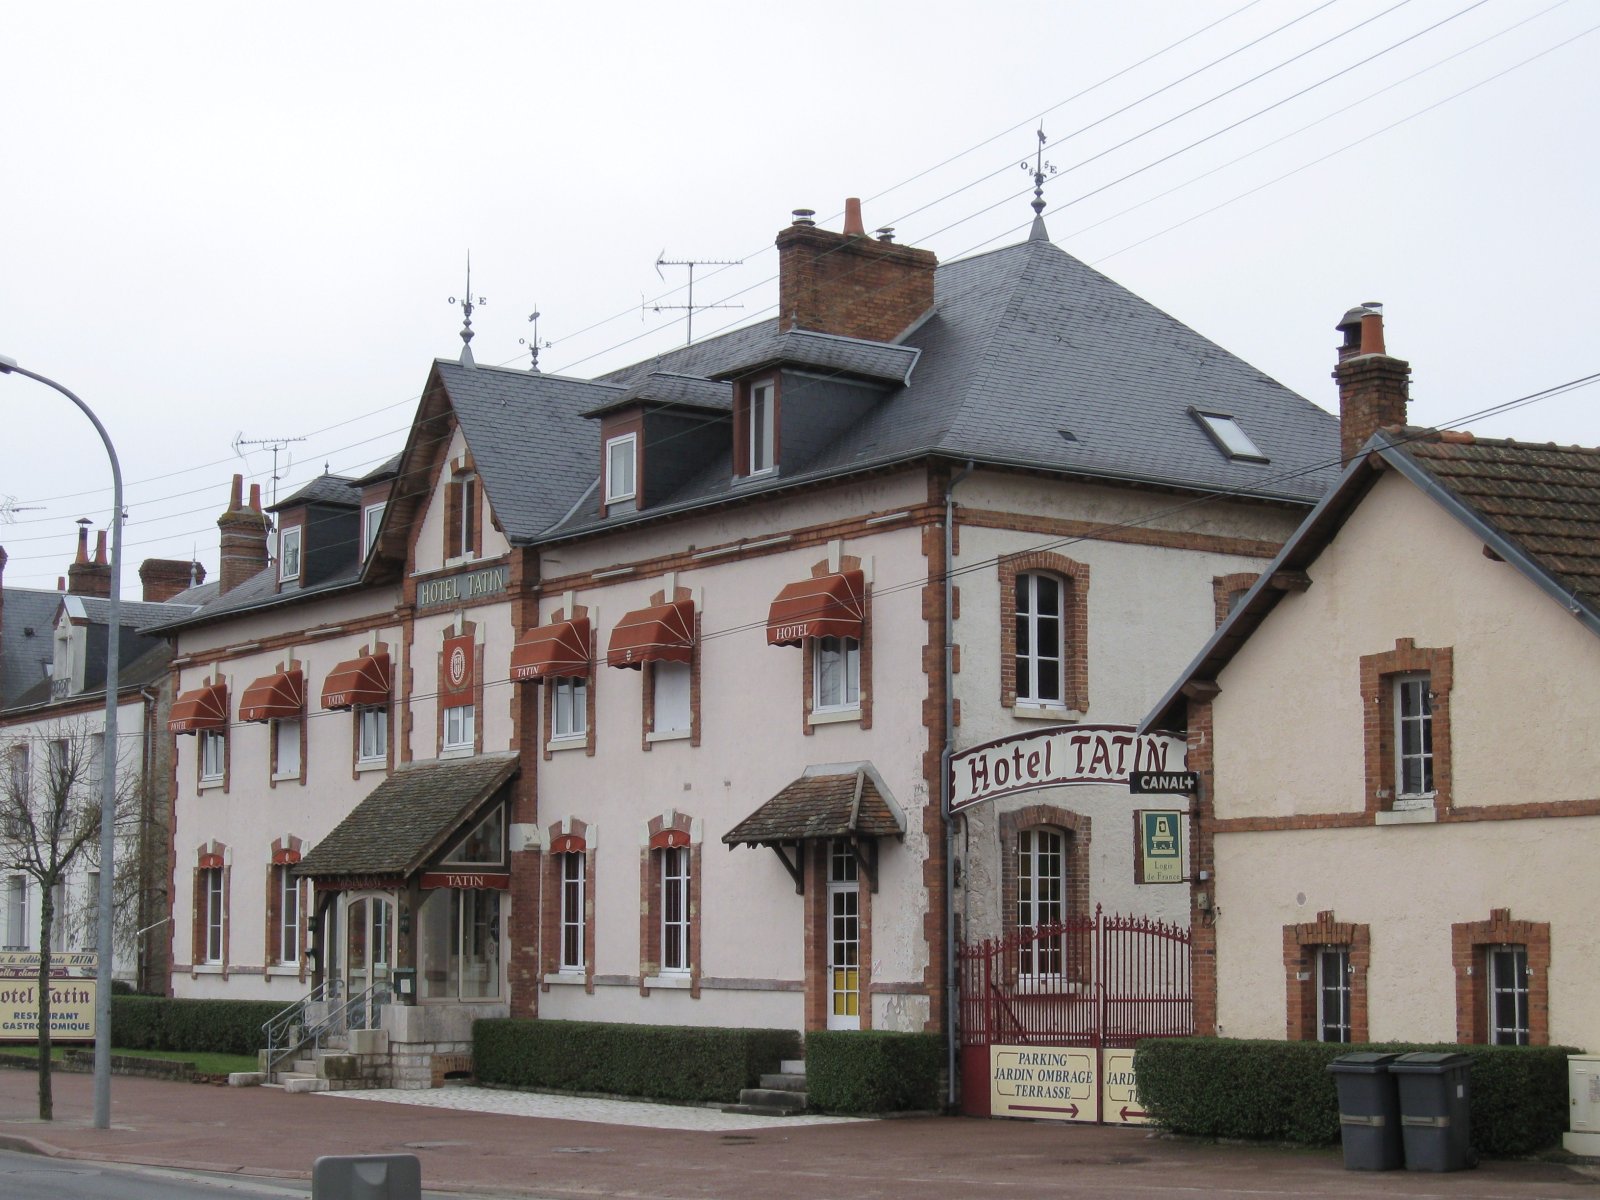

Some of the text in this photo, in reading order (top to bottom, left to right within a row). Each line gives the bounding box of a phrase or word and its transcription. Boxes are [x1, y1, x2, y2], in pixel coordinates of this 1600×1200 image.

[468, 568, 504, 595] TATIN
[776, 624, 808, 639] HOTEL
[517, 665, 539, 677] TATIN
[968, 736, 1169, 794] Hotel TATIN
[1141, 775, 1194, 789] CANAL+
[1154, 861, 1173, 871] Logis
[446, 875, 484, 886] TATIN
[1147, 872, 1180, 881] de France
[70, 956, 94, 964] TATIN
[0, 987, 33, 1004] otel
[1018, 1052, 1067, 1066] PARKING
[994, 1068, 1093, 1084] JARDIN OMBRAGE
[1015, 1085, 1071, 1099] TERRASSE
